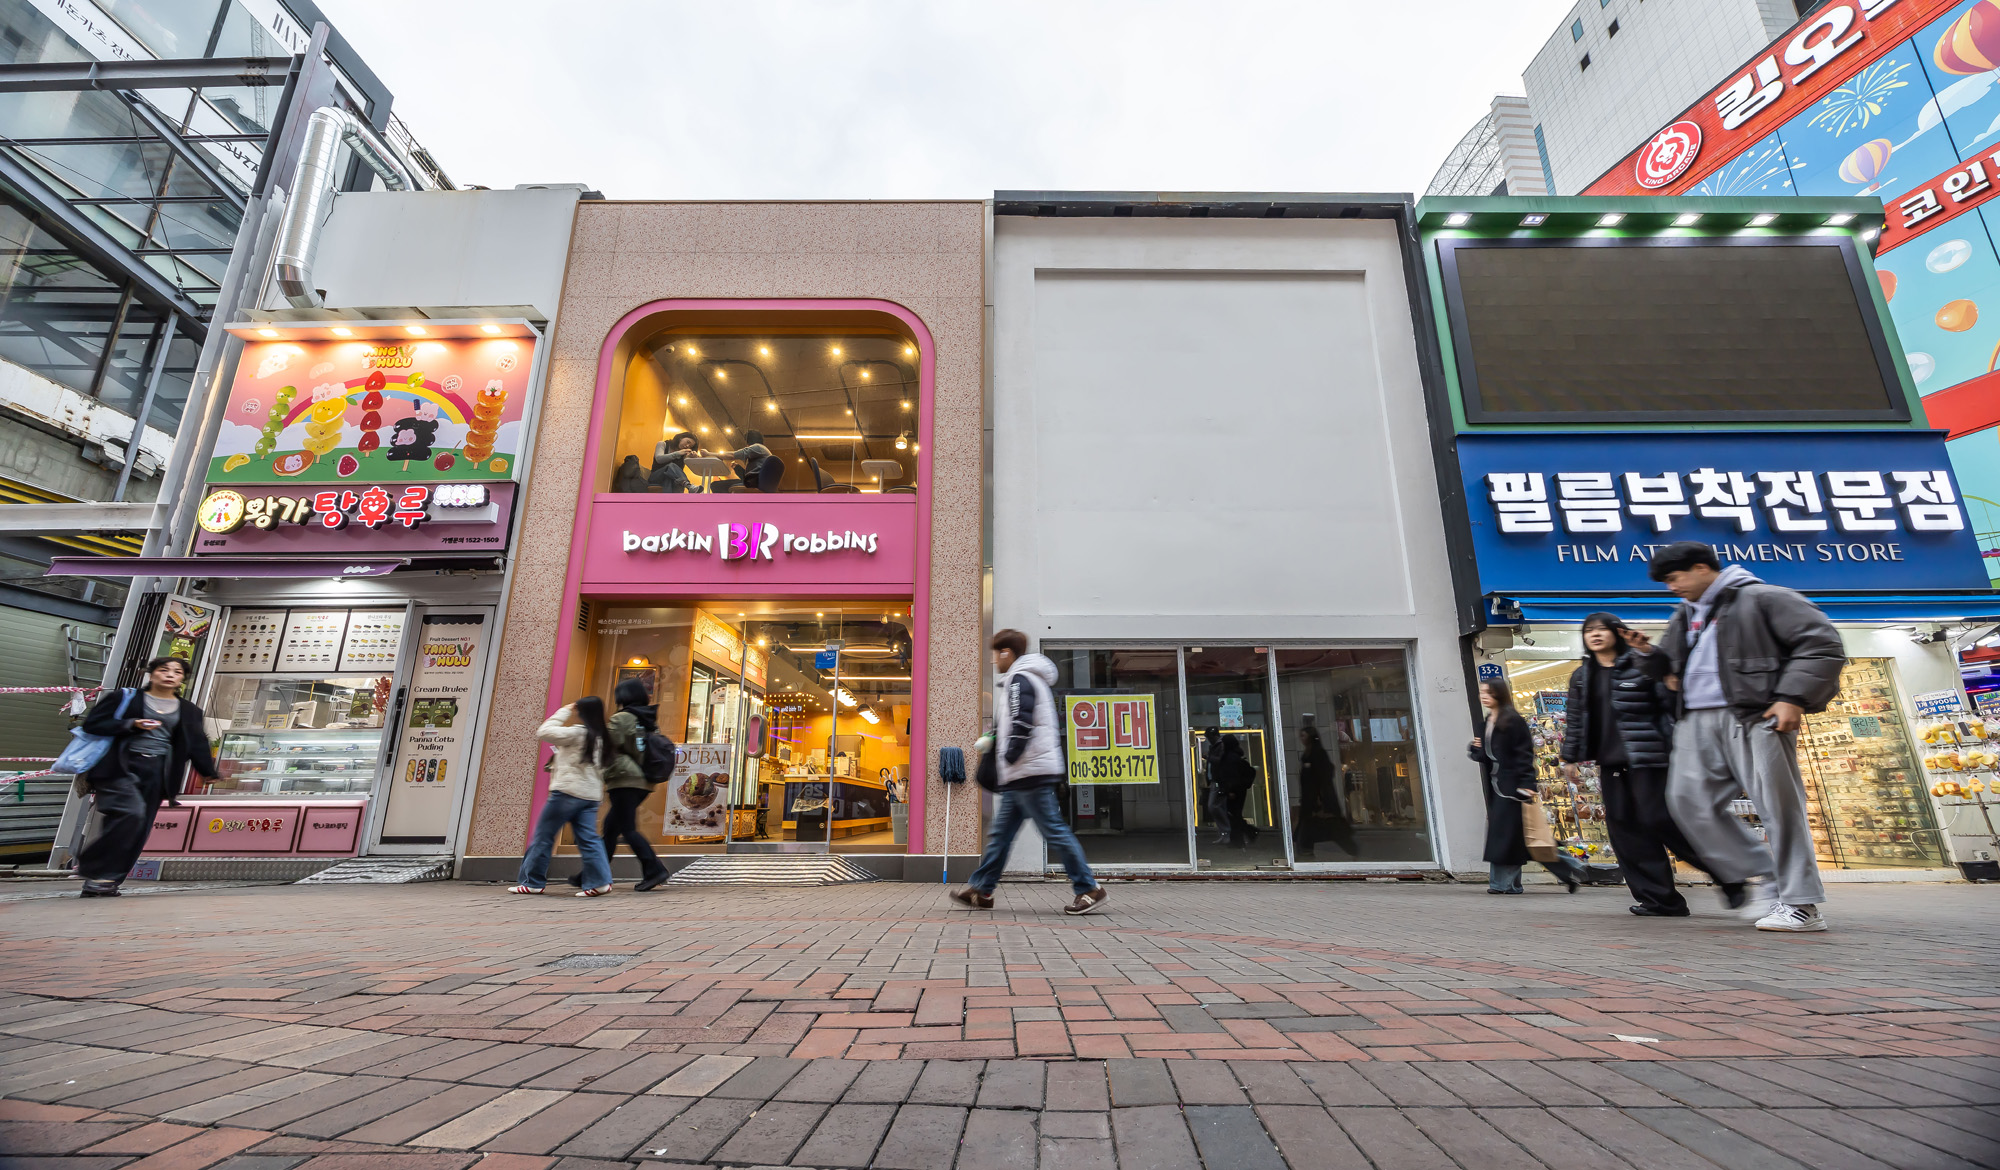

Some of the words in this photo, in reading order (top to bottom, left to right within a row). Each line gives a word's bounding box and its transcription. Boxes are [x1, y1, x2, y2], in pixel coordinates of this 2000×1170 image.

[1644, 177, 1664, 185] KING
[1666, 143, 1697, 181] ARCADE
[376, 357, 413, 368] HULU
[1486, 467, 1965, 533] 필름부착전문점
[466, 536, 500, 544] 1522-1509
[623, 528, 712, 555] baskin
[718, 522, 779, 560] BR
[784, 530, 878, 554] robbins
[1557, 544, 1619, 562] FILM
[1816, 543, 1905, 561] STORE
[423, 643, 457, 656] TANG
[436, 655, 471, 667] HULU
[1480, 666, 1500, 675] 33-2
[1072, 700, 1151, 750] 임대
[1851, 716, 1877, 728] 유리문
[417, 743, 444, 752] Puding
[675, 750, 727, 765] DUBAI
[1070, 754, 1156, 778] 010-3513-1717
[247, 818, 284, 833] 탕후루
